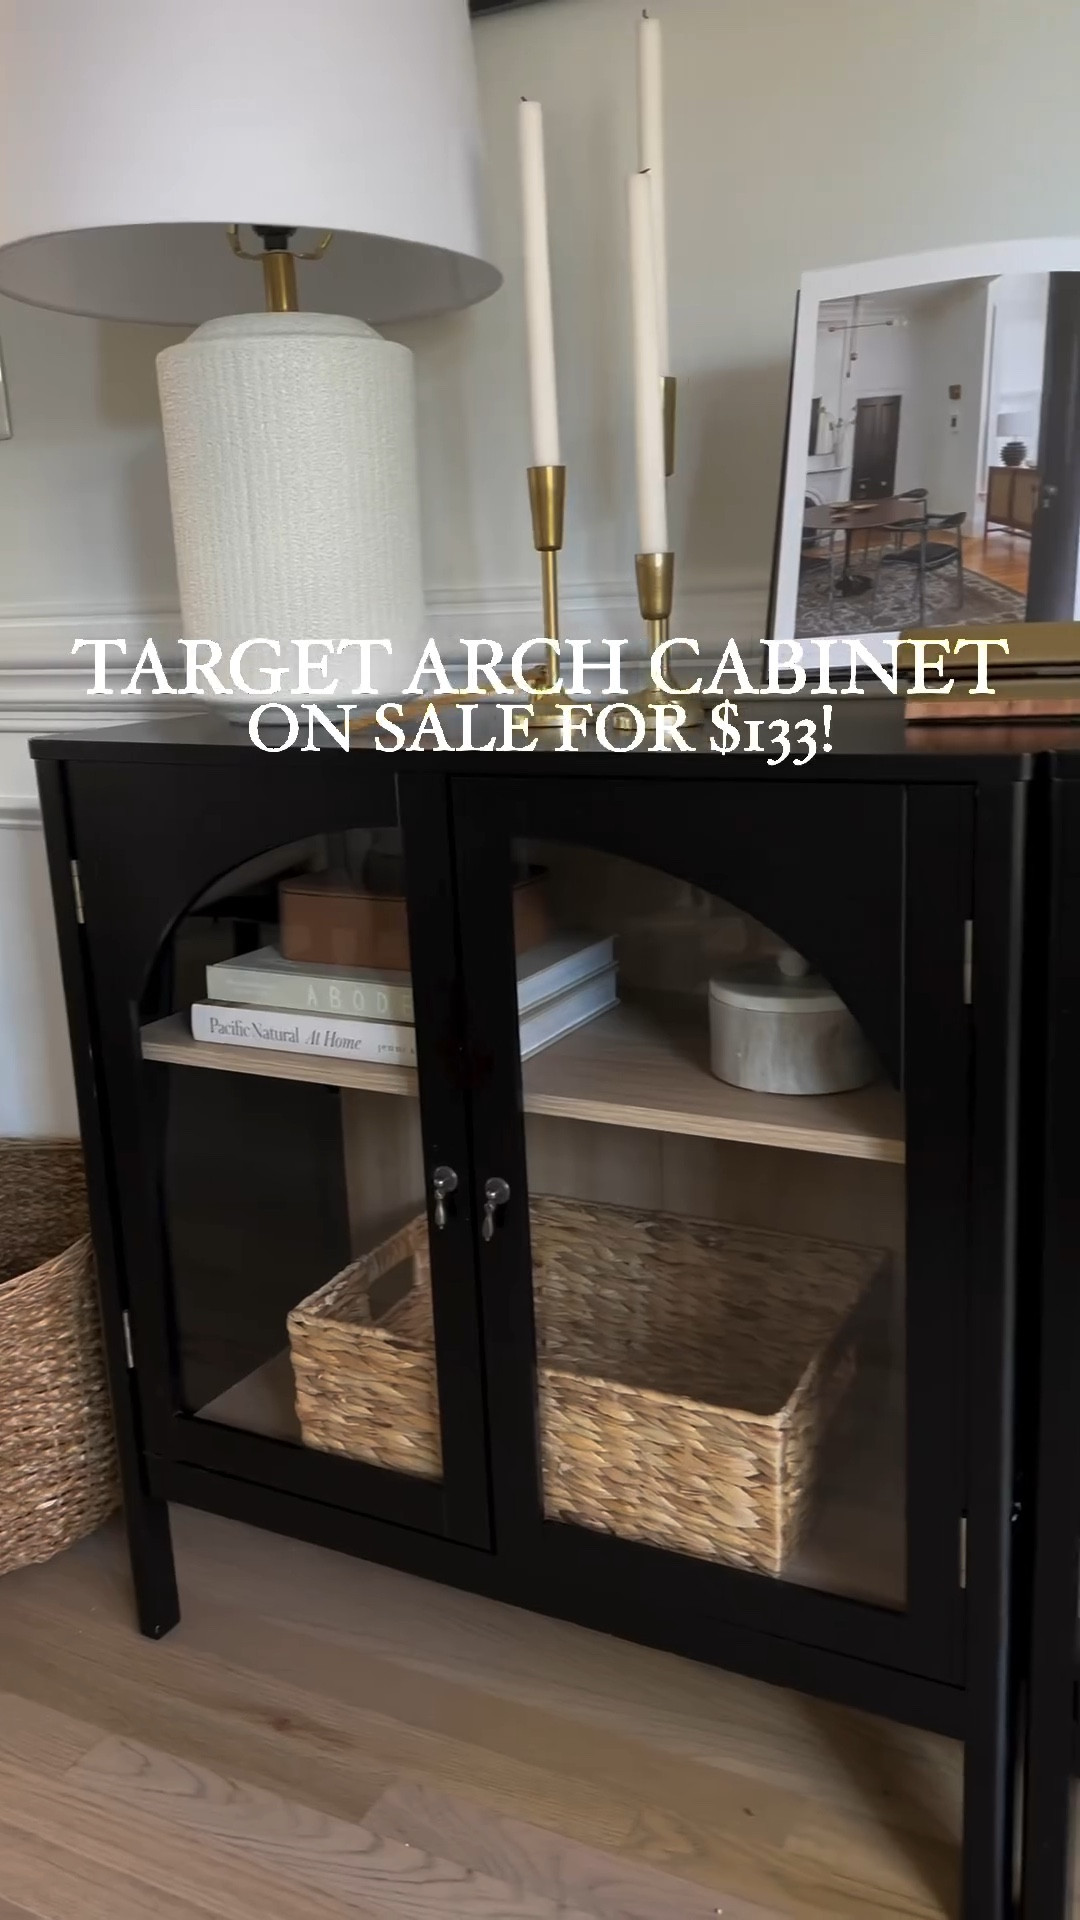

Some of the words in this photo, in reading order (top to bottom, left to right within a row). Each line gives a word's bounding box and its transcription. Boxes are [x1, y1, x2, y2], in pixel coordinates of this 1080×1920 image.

[209, 1016, 250, 1038] Pacific
[250, 1021, 300, 1043] Natural
[304, 1030, 321, 1046] At
[323, 1030, 362, 1050] Home
